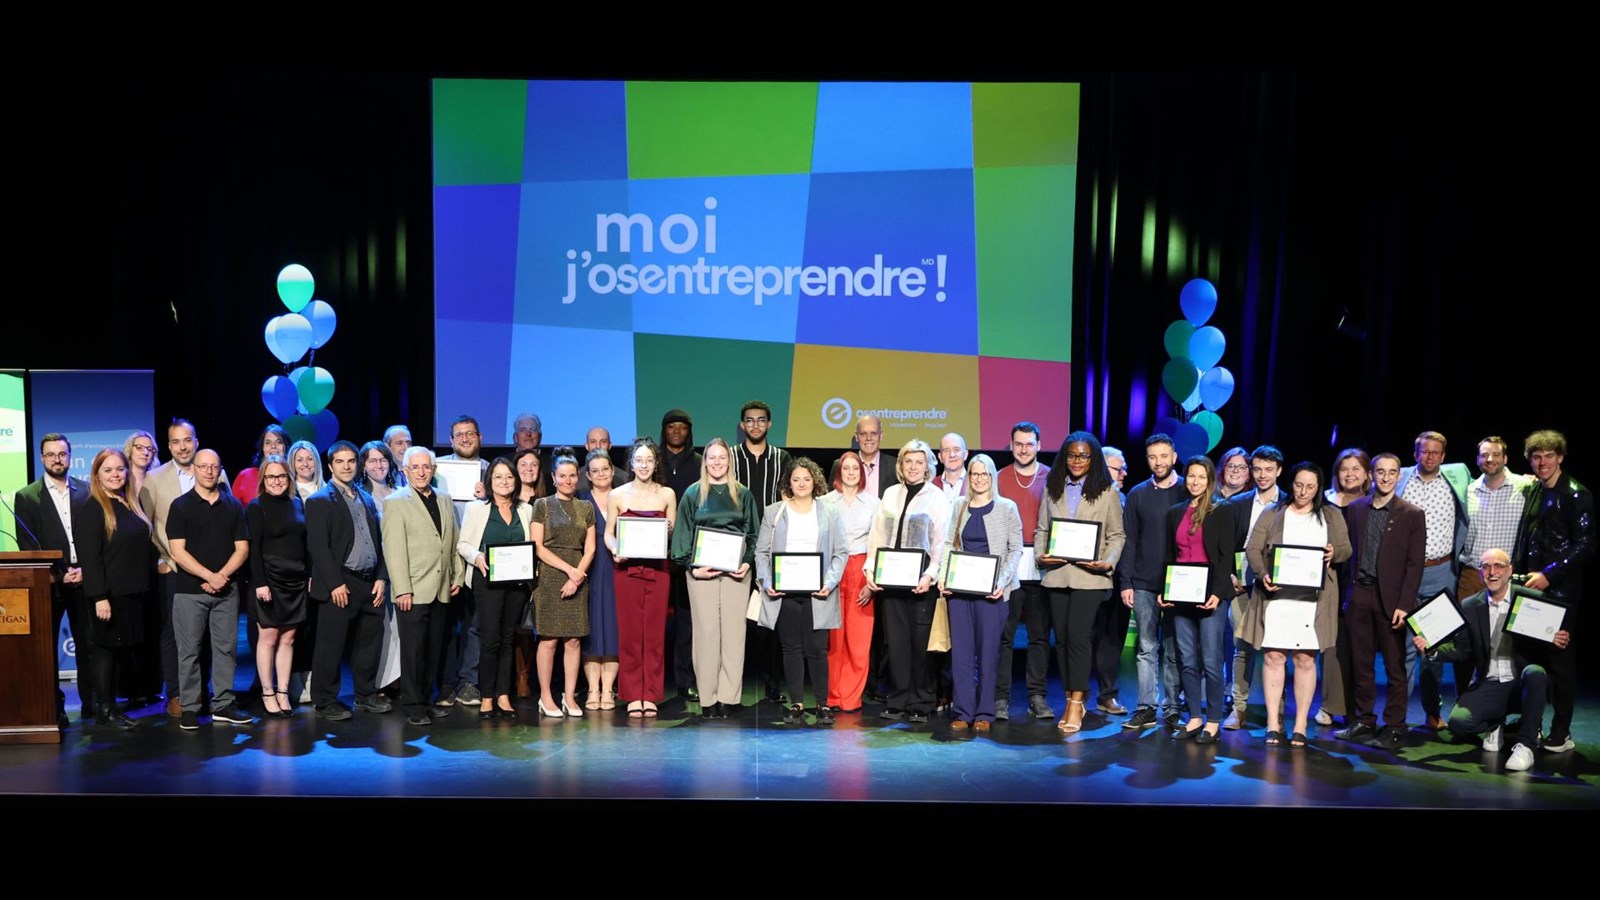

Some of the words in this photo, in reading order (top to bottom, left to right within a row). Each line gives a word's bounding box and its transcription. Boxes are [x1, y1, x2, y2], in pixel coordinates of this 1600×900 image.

[596, 196, 717, 254] moi
[562, 249, 927, 305] j’osentreprendre
[921, 258, 935, 266] MD
[856, 408, 947, 421] osentreprendre
